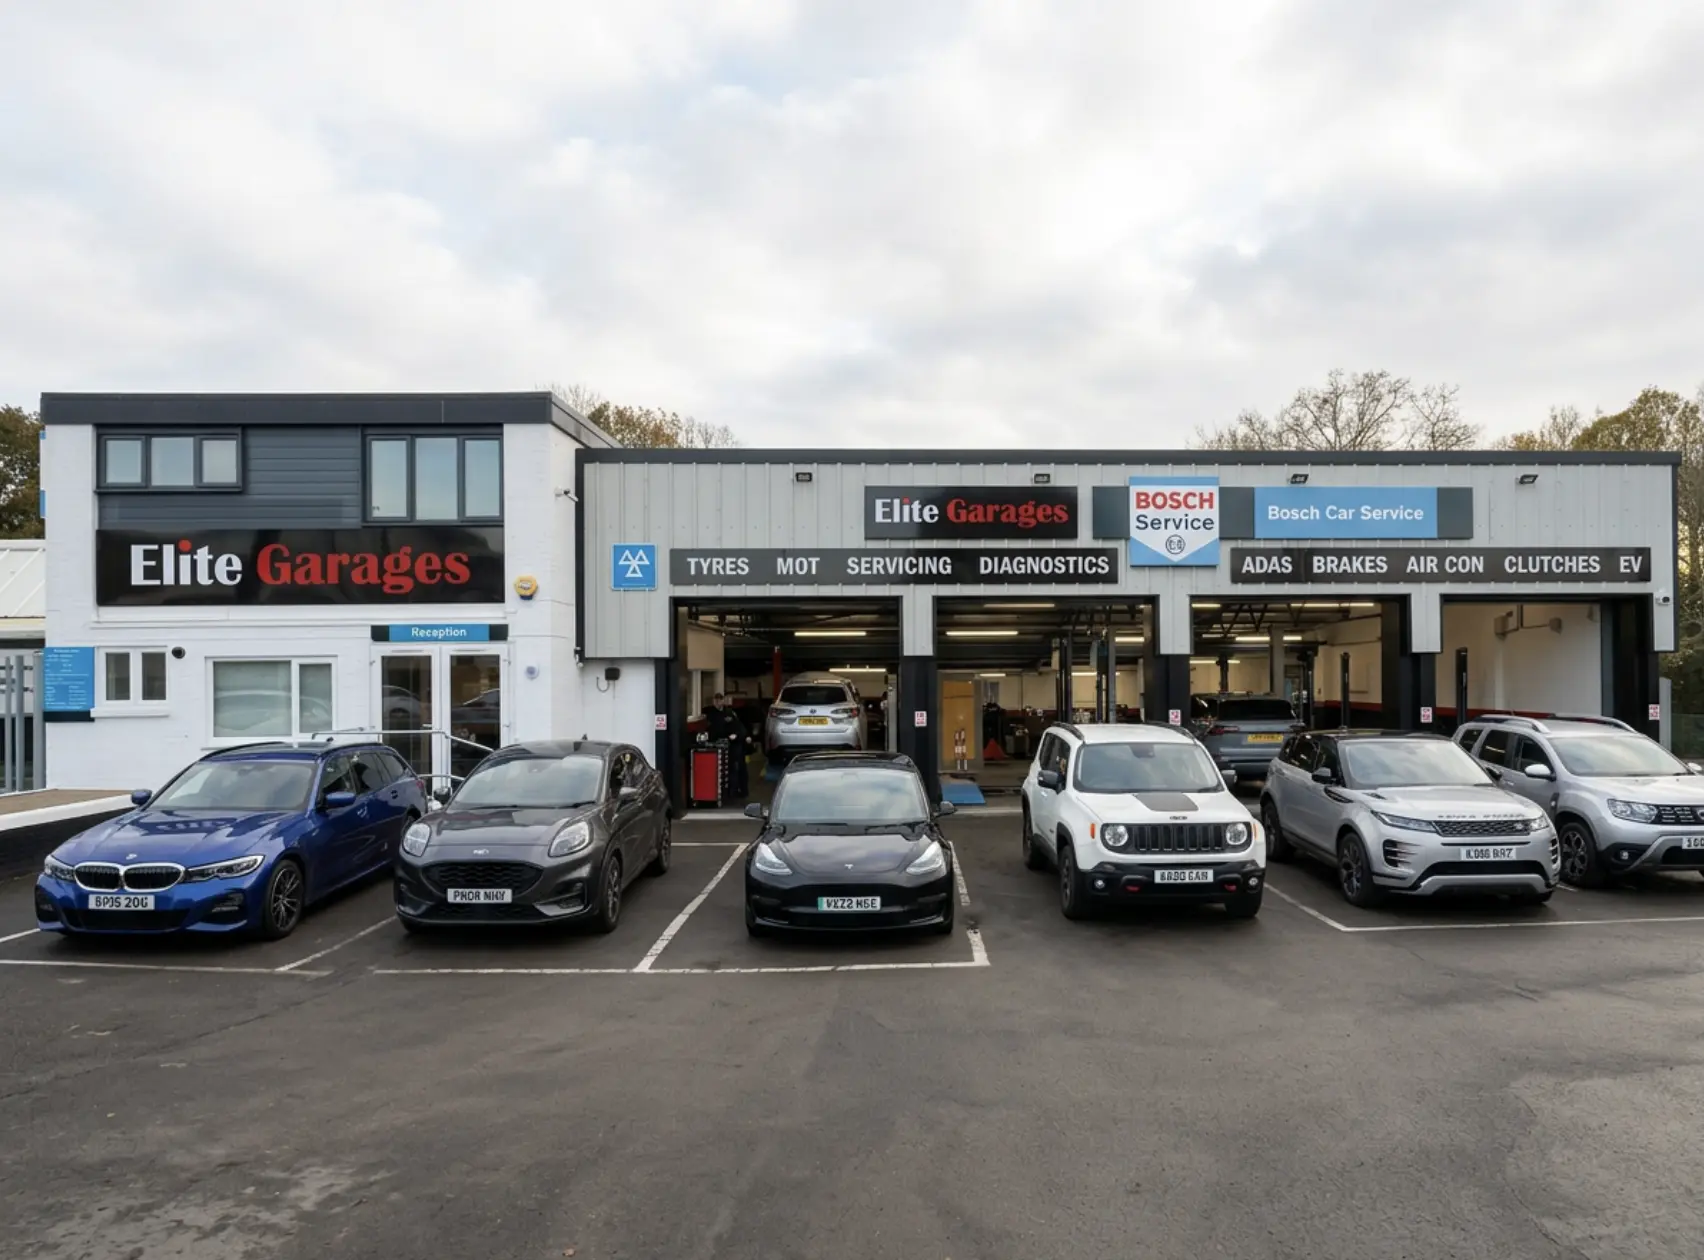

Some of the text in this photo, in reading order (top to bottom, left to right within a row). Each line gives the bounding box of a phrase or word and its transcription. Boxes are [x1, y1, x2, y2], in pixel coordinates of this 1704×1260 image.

[1135, 492, 1215, 510] BOSCH
[875, 497, 1069, 528] Elite Garages
[1268, 505, 1424, 520] Bosch Car Service
[1135, 513, 1215, 531] Service
[130, 539, 470, 594] Elite Garages
[686, 556, 1110, 575] TYRES MOT SERVICING DIAGNOSTICS
[1241, 555, 1642, 574] ADAS BRAKES AIR CON CLUTCHES EV
[411, 626, 467, 641] Reception
